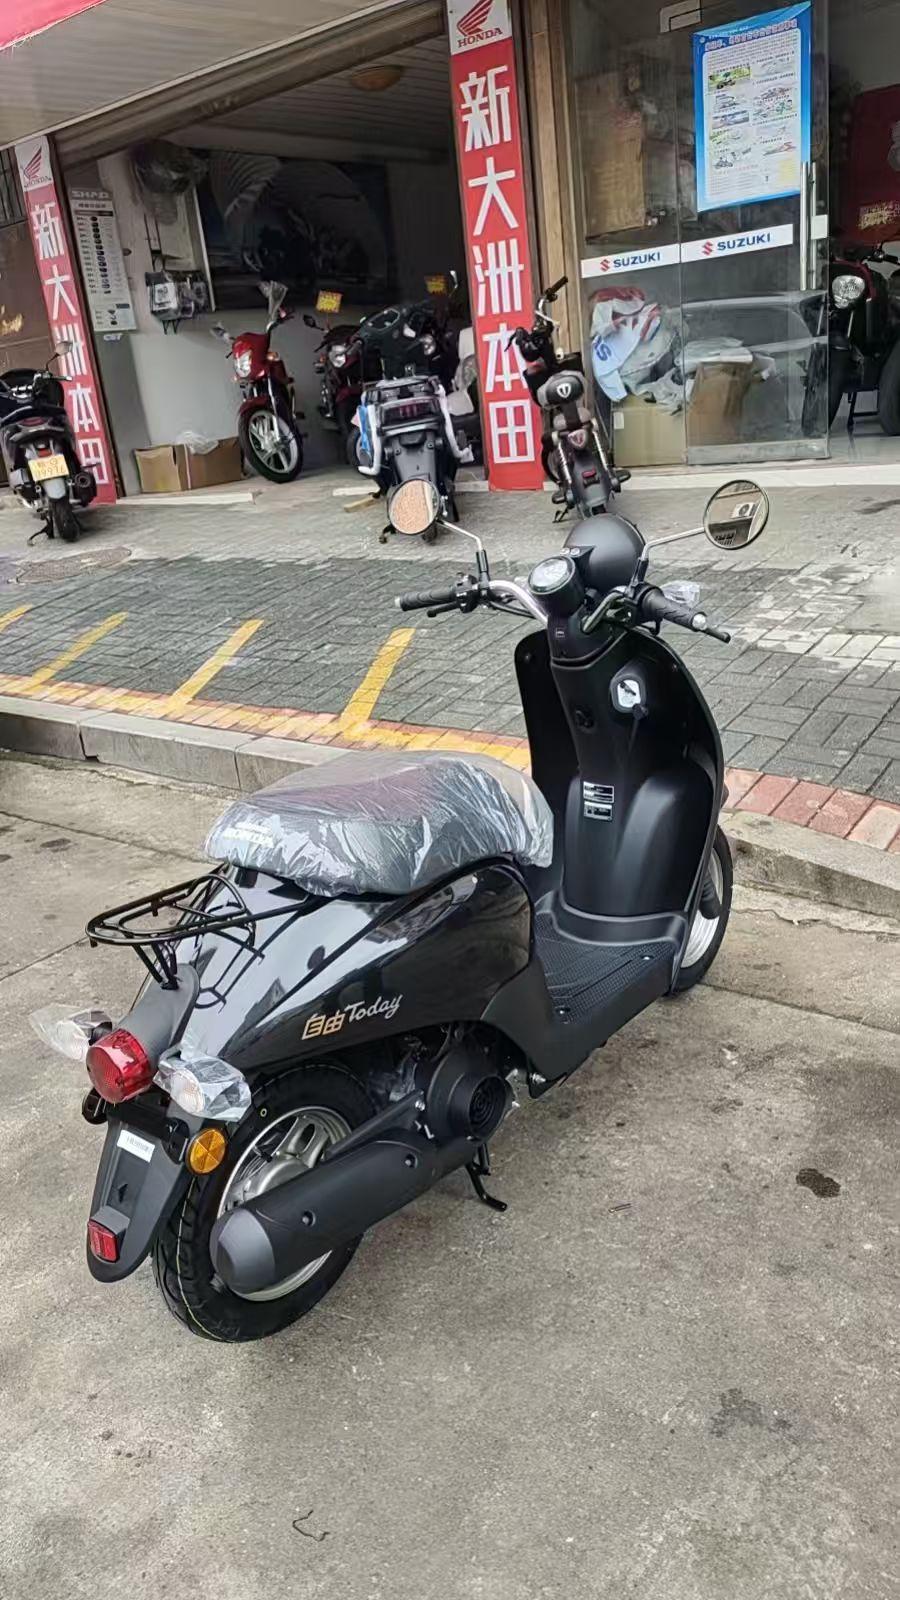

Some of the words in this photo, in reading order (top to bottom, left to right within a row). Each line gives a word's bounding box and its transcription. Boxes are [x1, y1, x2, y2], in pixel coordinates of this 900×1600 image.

[457, 27, 503, 48] HONDA
[24, 175, 51, 188] HONDA
[717, 232, 771, 251] SUZUKI
[459, 65, 535, 464] 新大洲本田
[613, 251, 661, 268] SUZUKI
[30, 201, 109, 485] 新大洲本田
[302, 1009, 345, 1040] 自由
[344, 994, 403, 1022] Today
